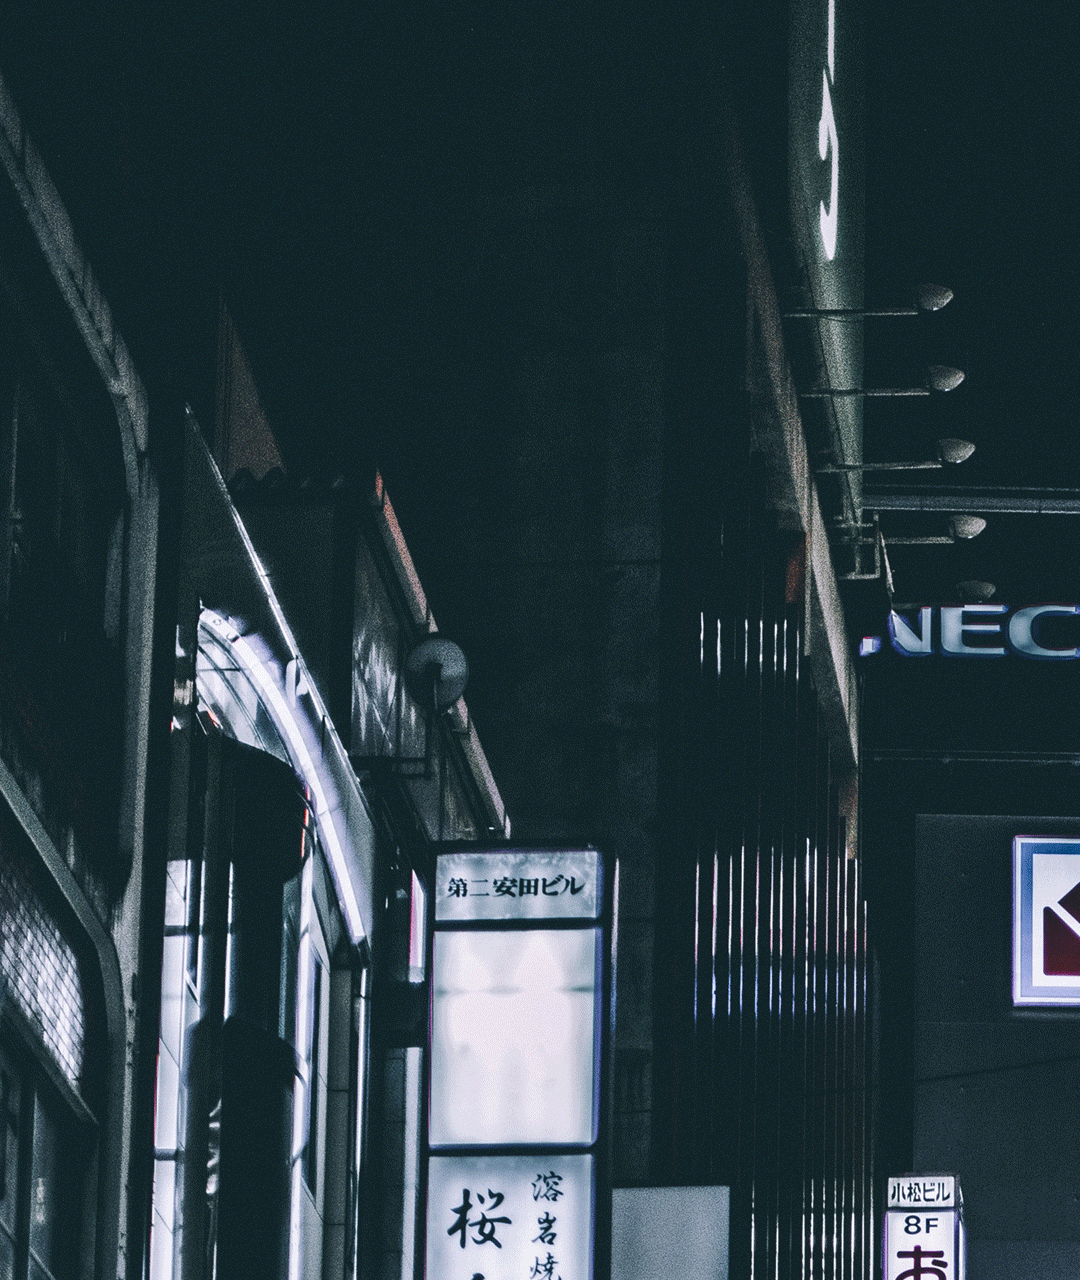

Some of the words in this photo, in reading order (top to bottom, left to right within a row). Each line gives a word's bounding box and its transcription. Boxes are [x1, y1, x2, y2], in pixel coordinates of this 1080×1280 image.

[447, 874, 585, 899] 第二安田ビル
[891, 1181, 951, 1204] 小松ビル
[903, 1215, 939, 1236] 8F
